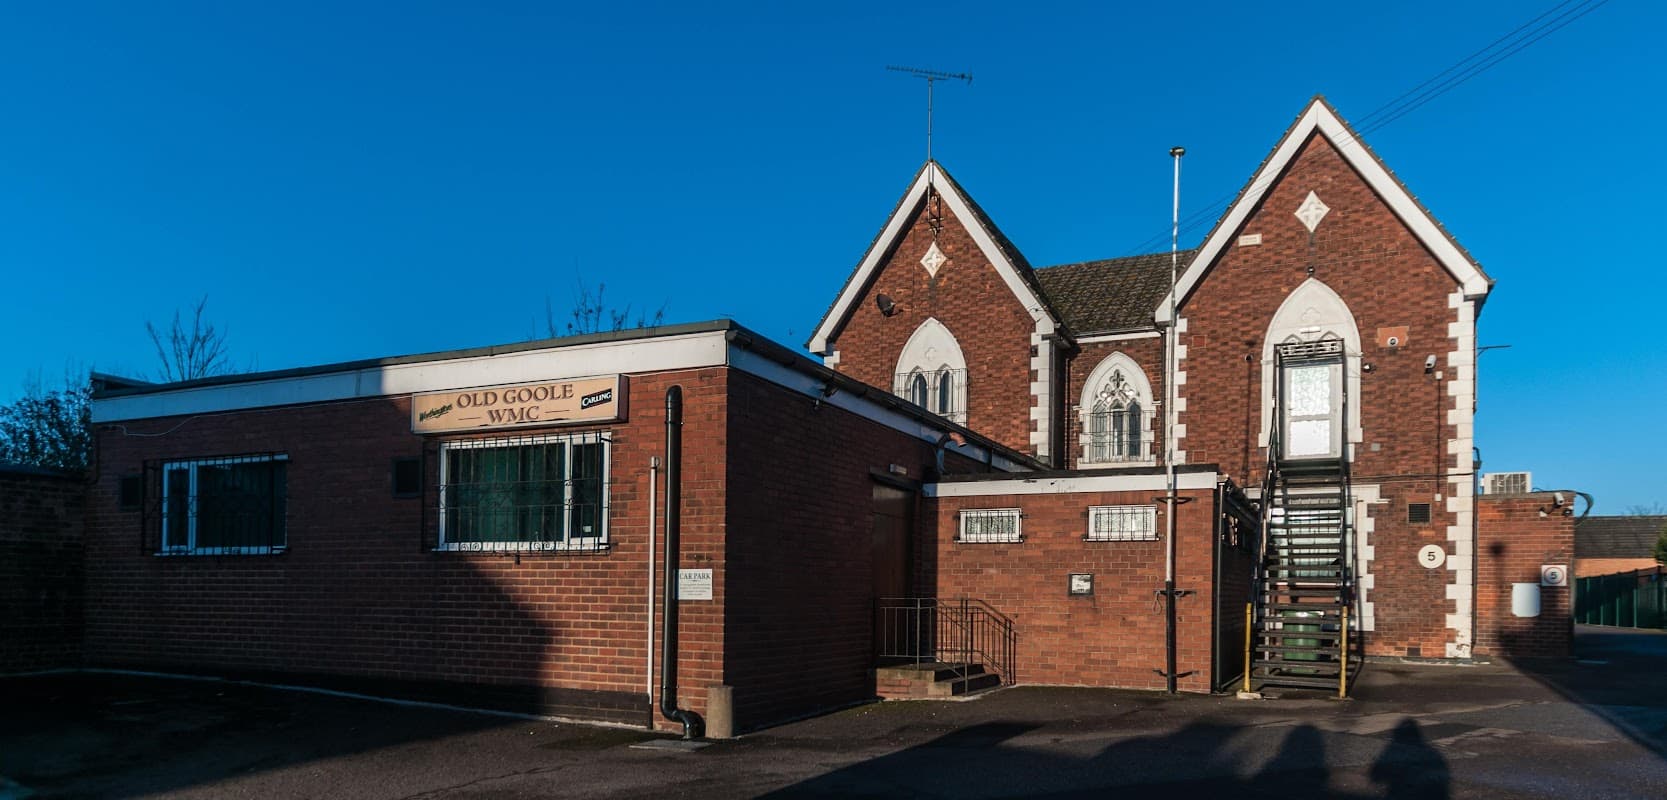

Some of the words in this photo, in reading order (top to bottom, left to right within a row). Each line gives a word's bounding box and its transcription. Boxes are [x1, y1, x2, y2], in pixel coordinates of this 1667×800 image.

[457, 391, 498, 408] OLD
[503, 384, 574, 404] GOOLE
[582, 392, 612, 406] CARLING
[487, 405, 539, 423] WMC
[1427, 551, 1436, 561] 5
[693, 572, 711, 580] PARK
[1551, 571, 1558, 580] 5
